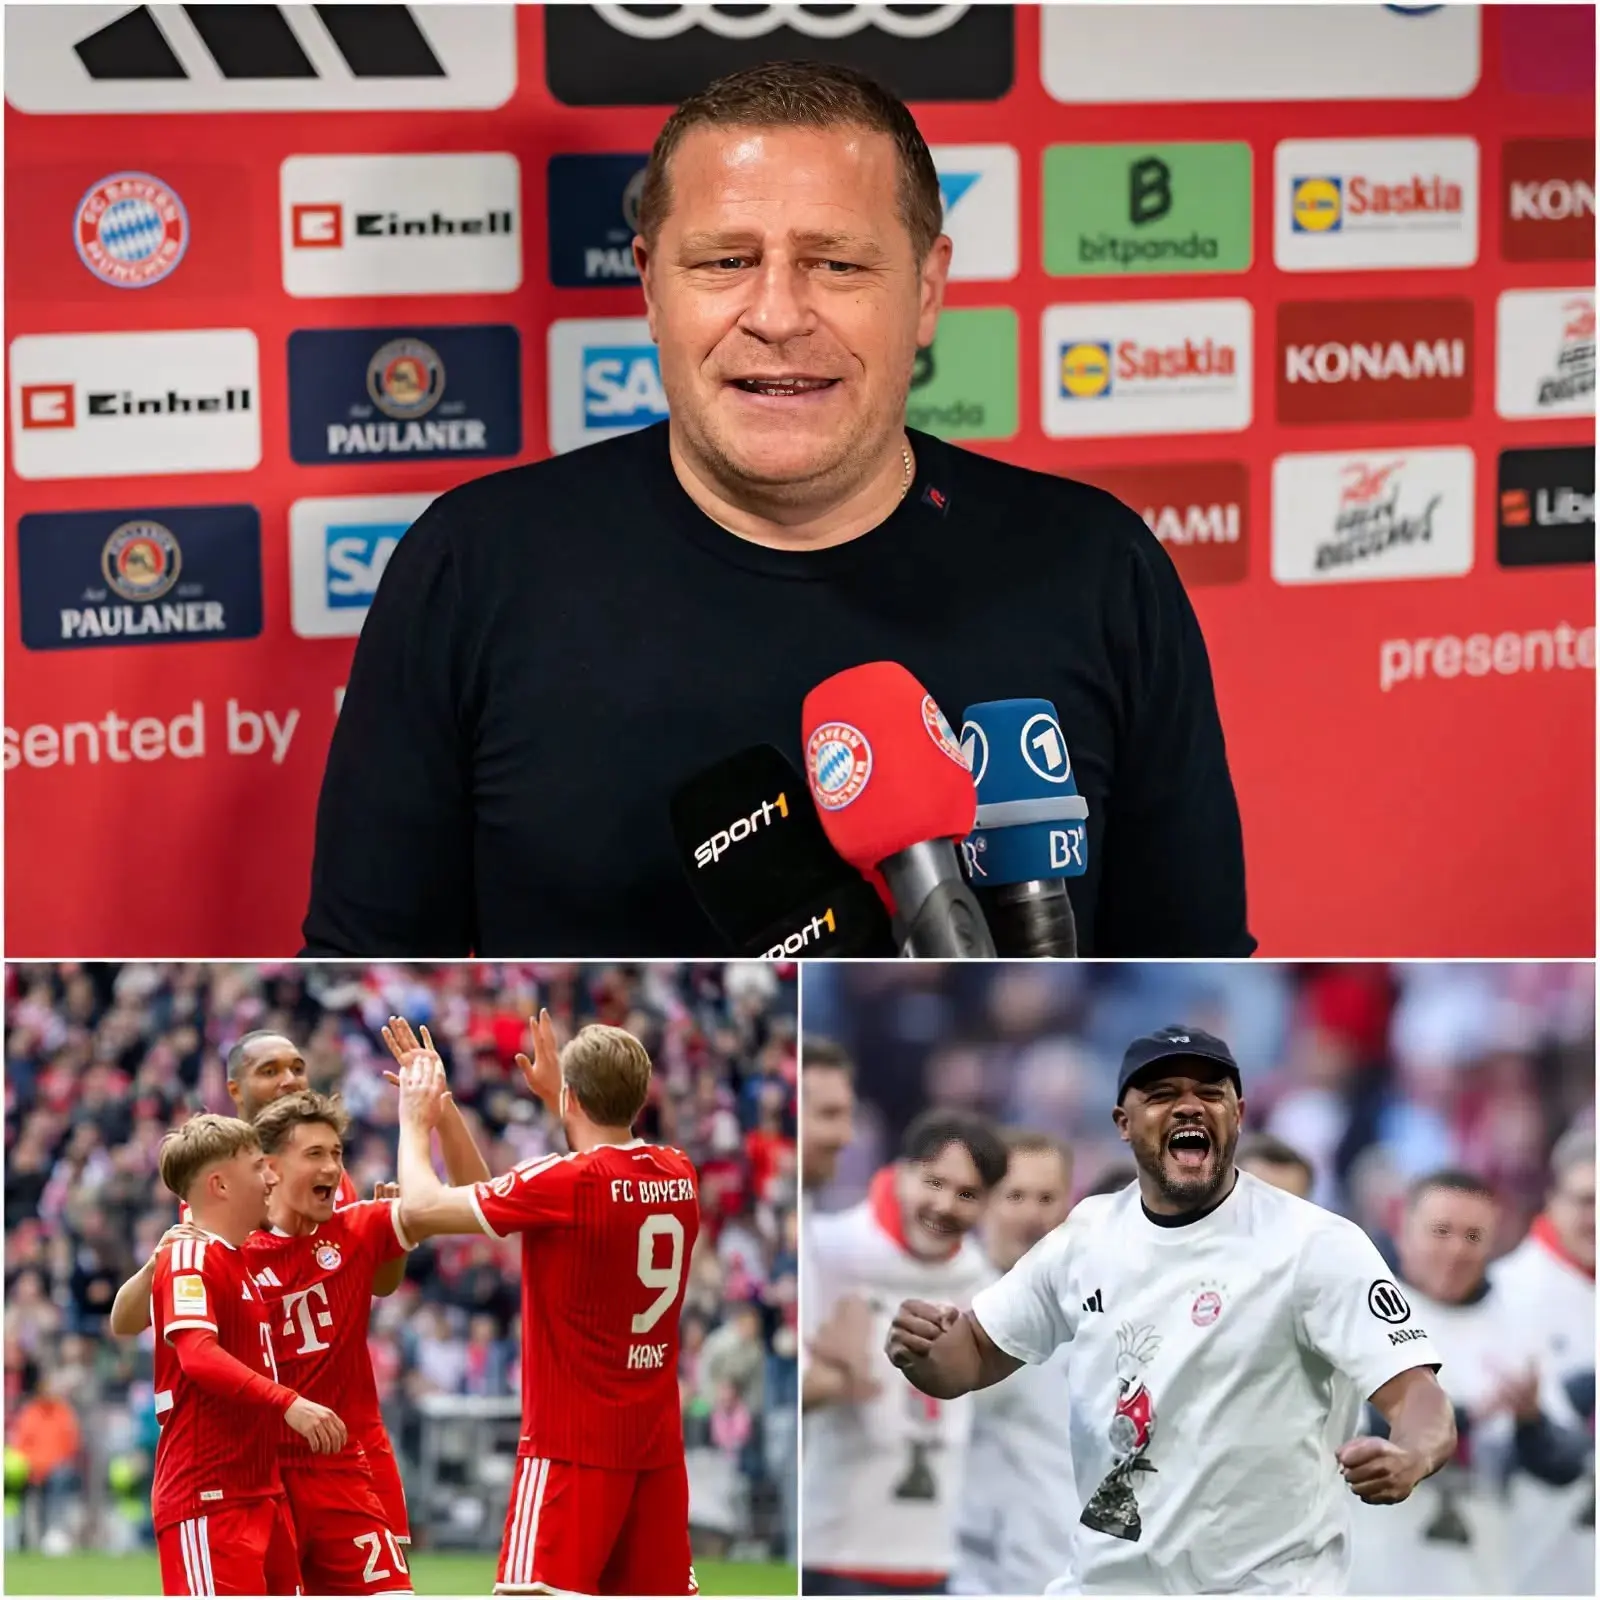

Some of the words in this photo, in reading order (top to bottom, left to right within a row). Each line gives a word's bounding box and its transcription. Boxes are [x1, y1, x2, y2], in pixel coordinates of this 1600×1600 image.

[1348, 174, 1464, 215] Saskia
[356, 210, 513, 236] Einhell
[1078, 230, 1219, 271] bitpanda
[1117, 336, 1236, 380] Saskia
[1285, 338, 1466, 384] KONAMI
[88, 389, 250, 416] Einhell
[327, 418, 487, 454] PAULANER
[60, 601, 226, 639] PAULANER
[226, 697, 300, 765] by
[1032, 727, 1062, 771] 1
[694, 792, 789, 869] sport1
[611, 1179, 634, 1203] FC
[631, 1213, 685, 1334] 9
[353, 1527, 409, 1584] 20
